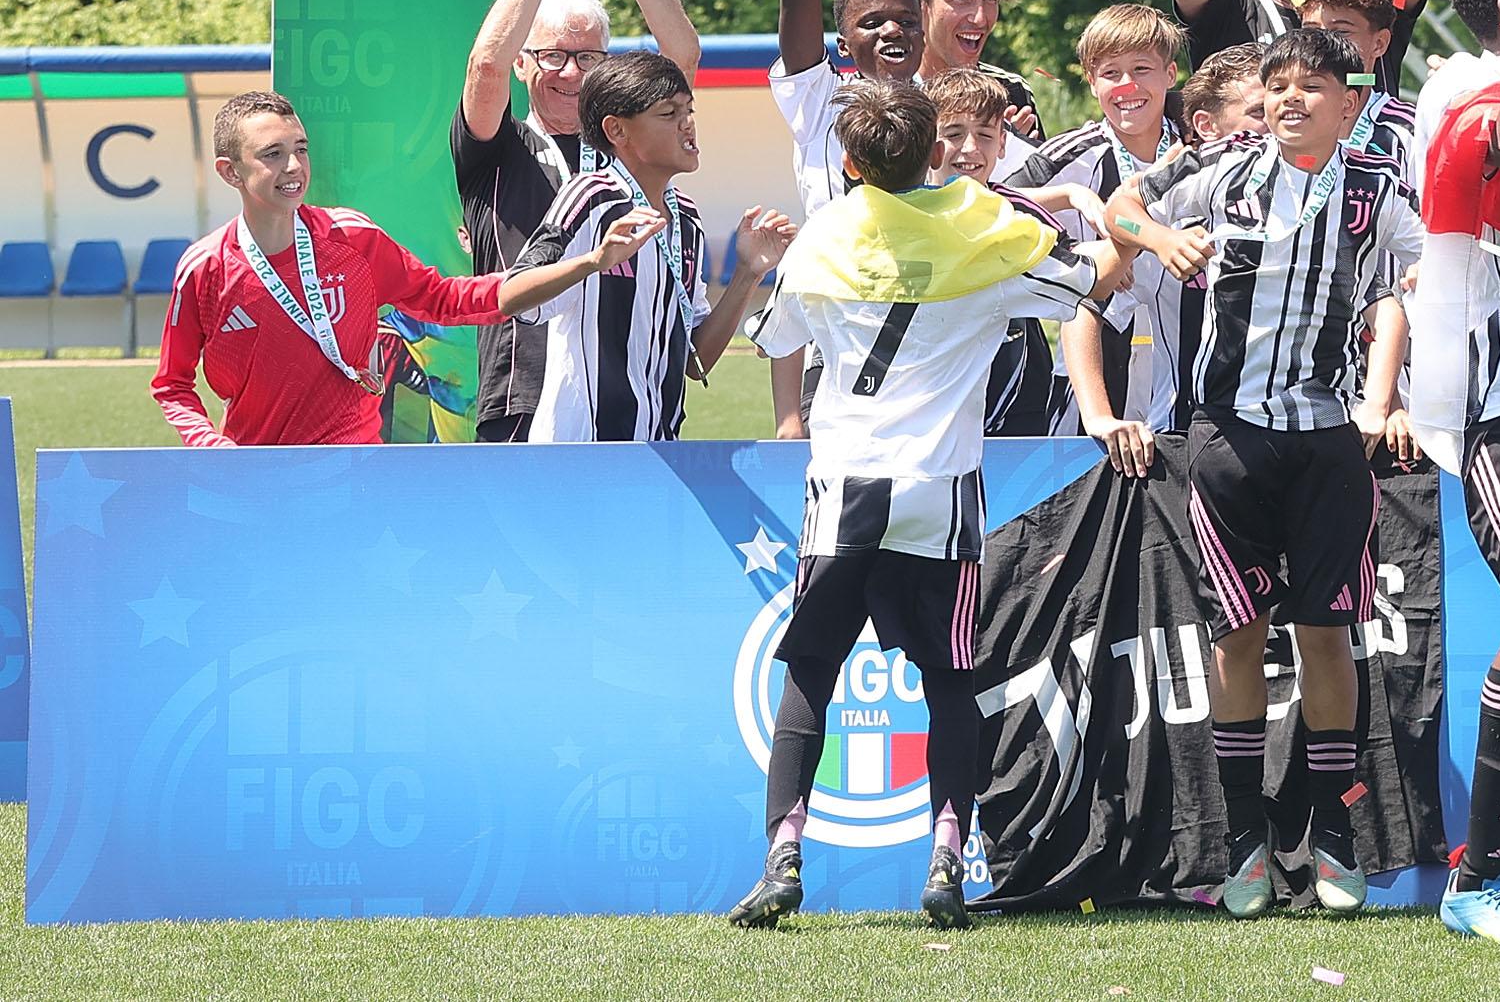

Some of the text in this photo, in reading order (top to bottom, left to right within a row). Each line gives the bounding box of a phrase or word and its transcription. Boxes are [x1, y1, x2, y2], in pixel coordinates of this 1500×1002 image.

[86, 124, 160, 198] C
[1317, 164, 1338, 196] 2026
[249, 243, 307, 326] FINALE 2026
[295, 228, 327, 321] FINALE 2026
[852, 260, 933, 397] 7
[841, 709, 890, 726] ITALIA
[224, 767, 426, 851] FIGC
[597, 820, 689, 862] FIGC
[287, 861, 362, 886] ITALIA
[624, 865, 661, 878] ITALIA
